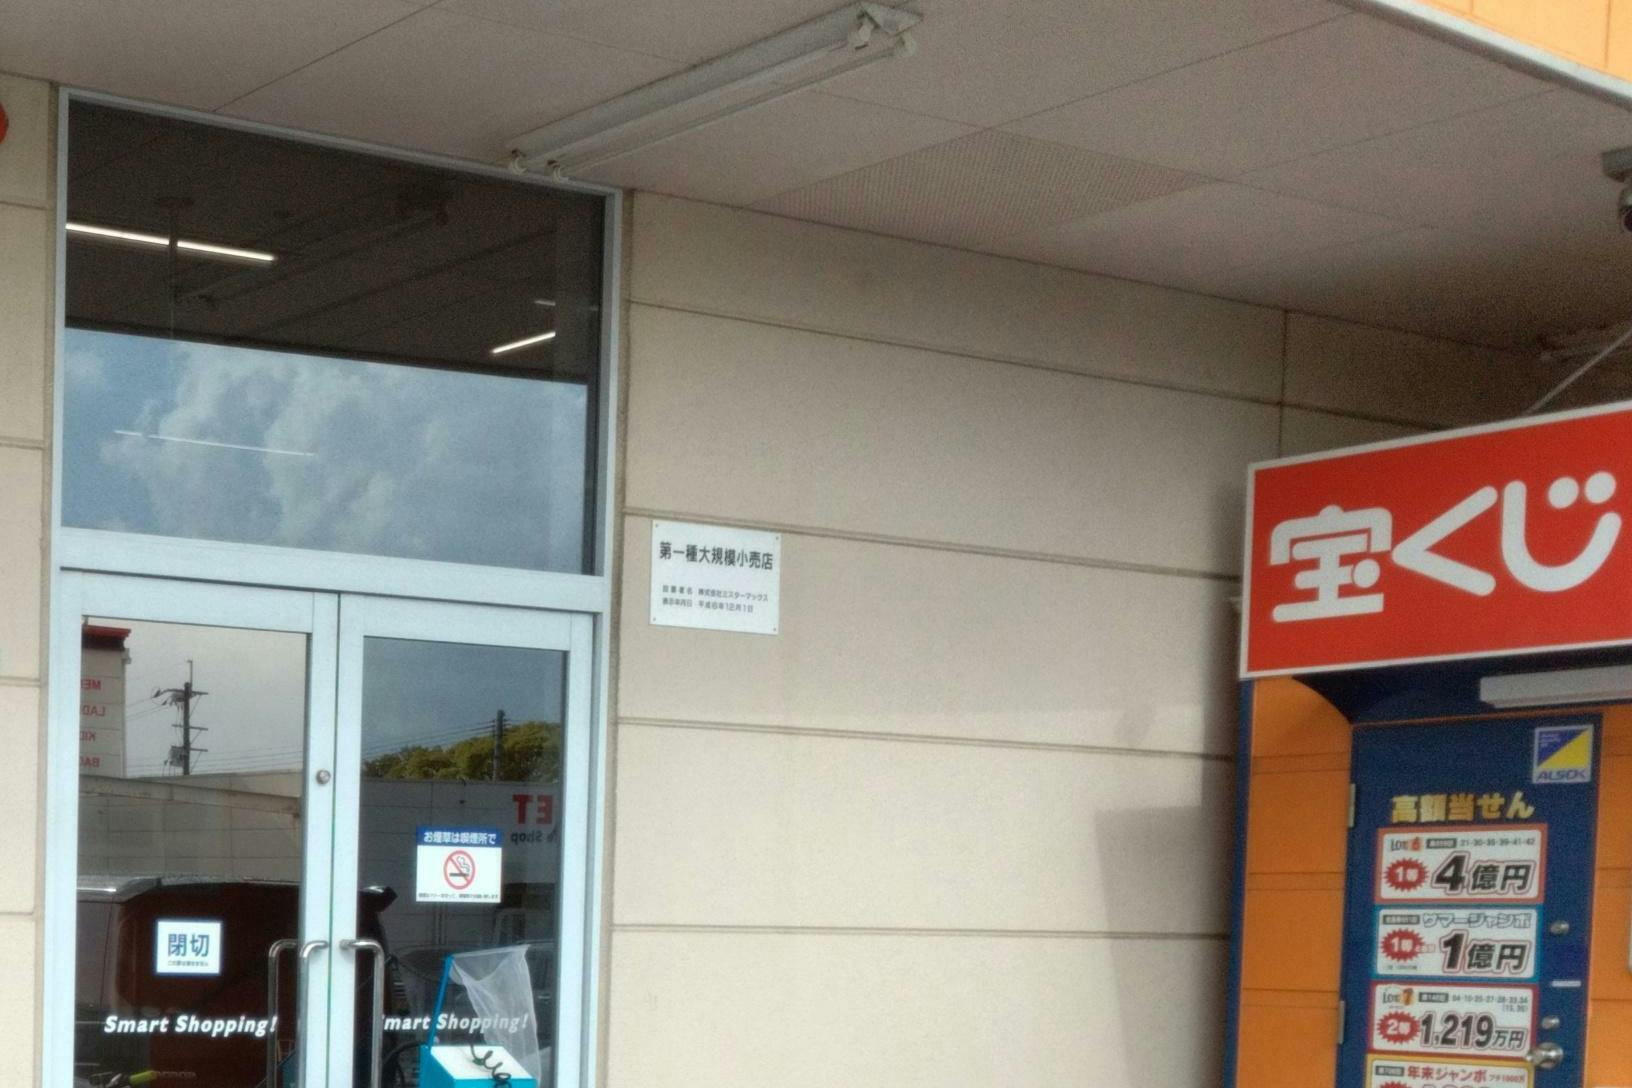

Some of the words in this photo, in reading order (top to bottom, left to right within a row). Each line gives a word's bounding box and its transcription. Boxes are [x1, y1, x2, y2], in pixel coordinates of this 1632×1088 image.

[659, 541, 773, 571] 第一種大規模小売店
[1270, 471, 1622, 622] 宝くじ
[1391, 792, 1535, 823] 高額当せん
[1434, 853, 1532, 892] 4億円
[1423, 913, 1532, 928] サマージャンボ
[167, 932, 210, 957] 閉切
[1443, 932, 1527, 970] 1億円
[104, 1015, 169, 1034] Smart
[175, 1014, 278, 1037] Shopping!
[382, 1014, 431, 1031] mart
[436, 1013, 529, 1034] Shopping!
[1421, 1013, 1525, 1050] 1,219万円
[1407, 1065, 1487, 1084] 年末ジャンボ
